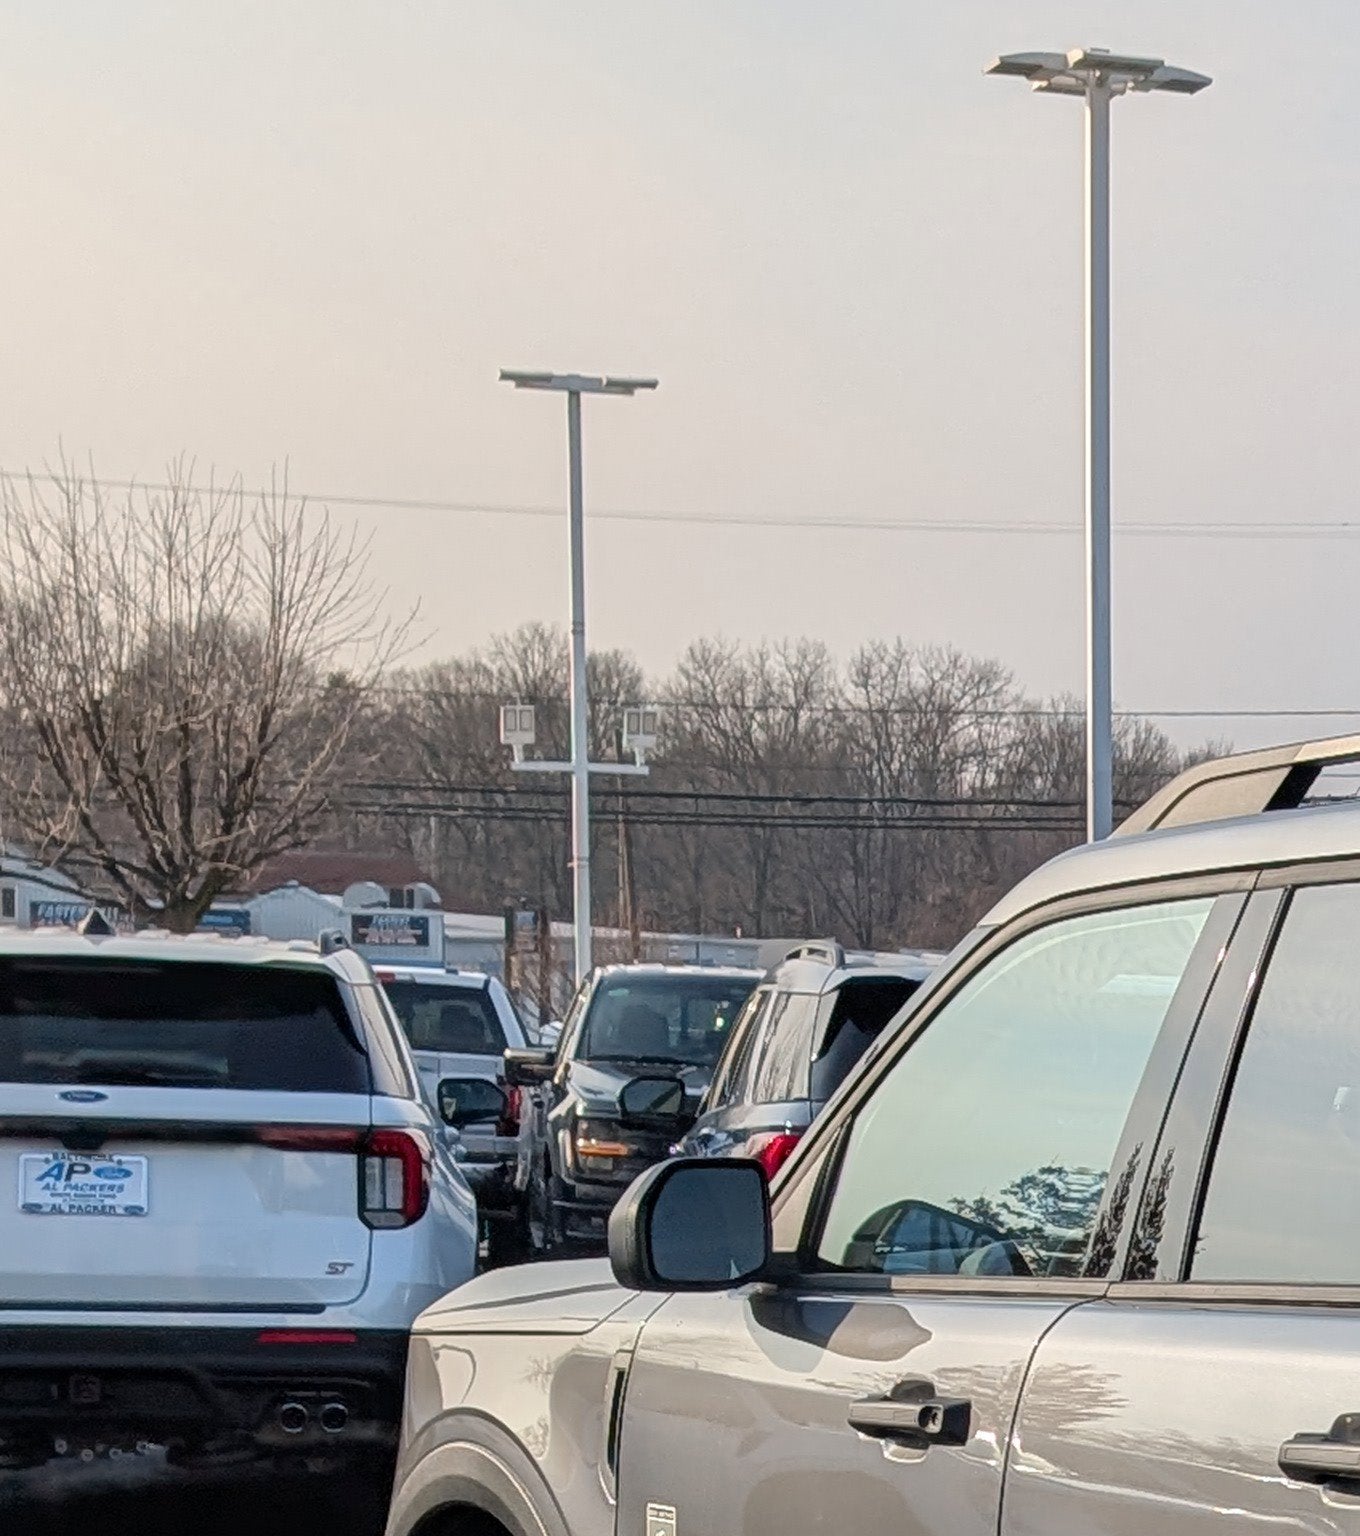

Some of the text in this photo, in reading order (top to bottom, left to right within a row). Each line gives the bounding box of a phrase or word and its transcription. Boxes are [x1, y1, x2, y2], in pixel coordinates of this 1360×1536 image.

[35, 1162, 92, 1182] AP
[50, 1205, 65, 1214] AL
[325, 1262, 355, 1275] ST
